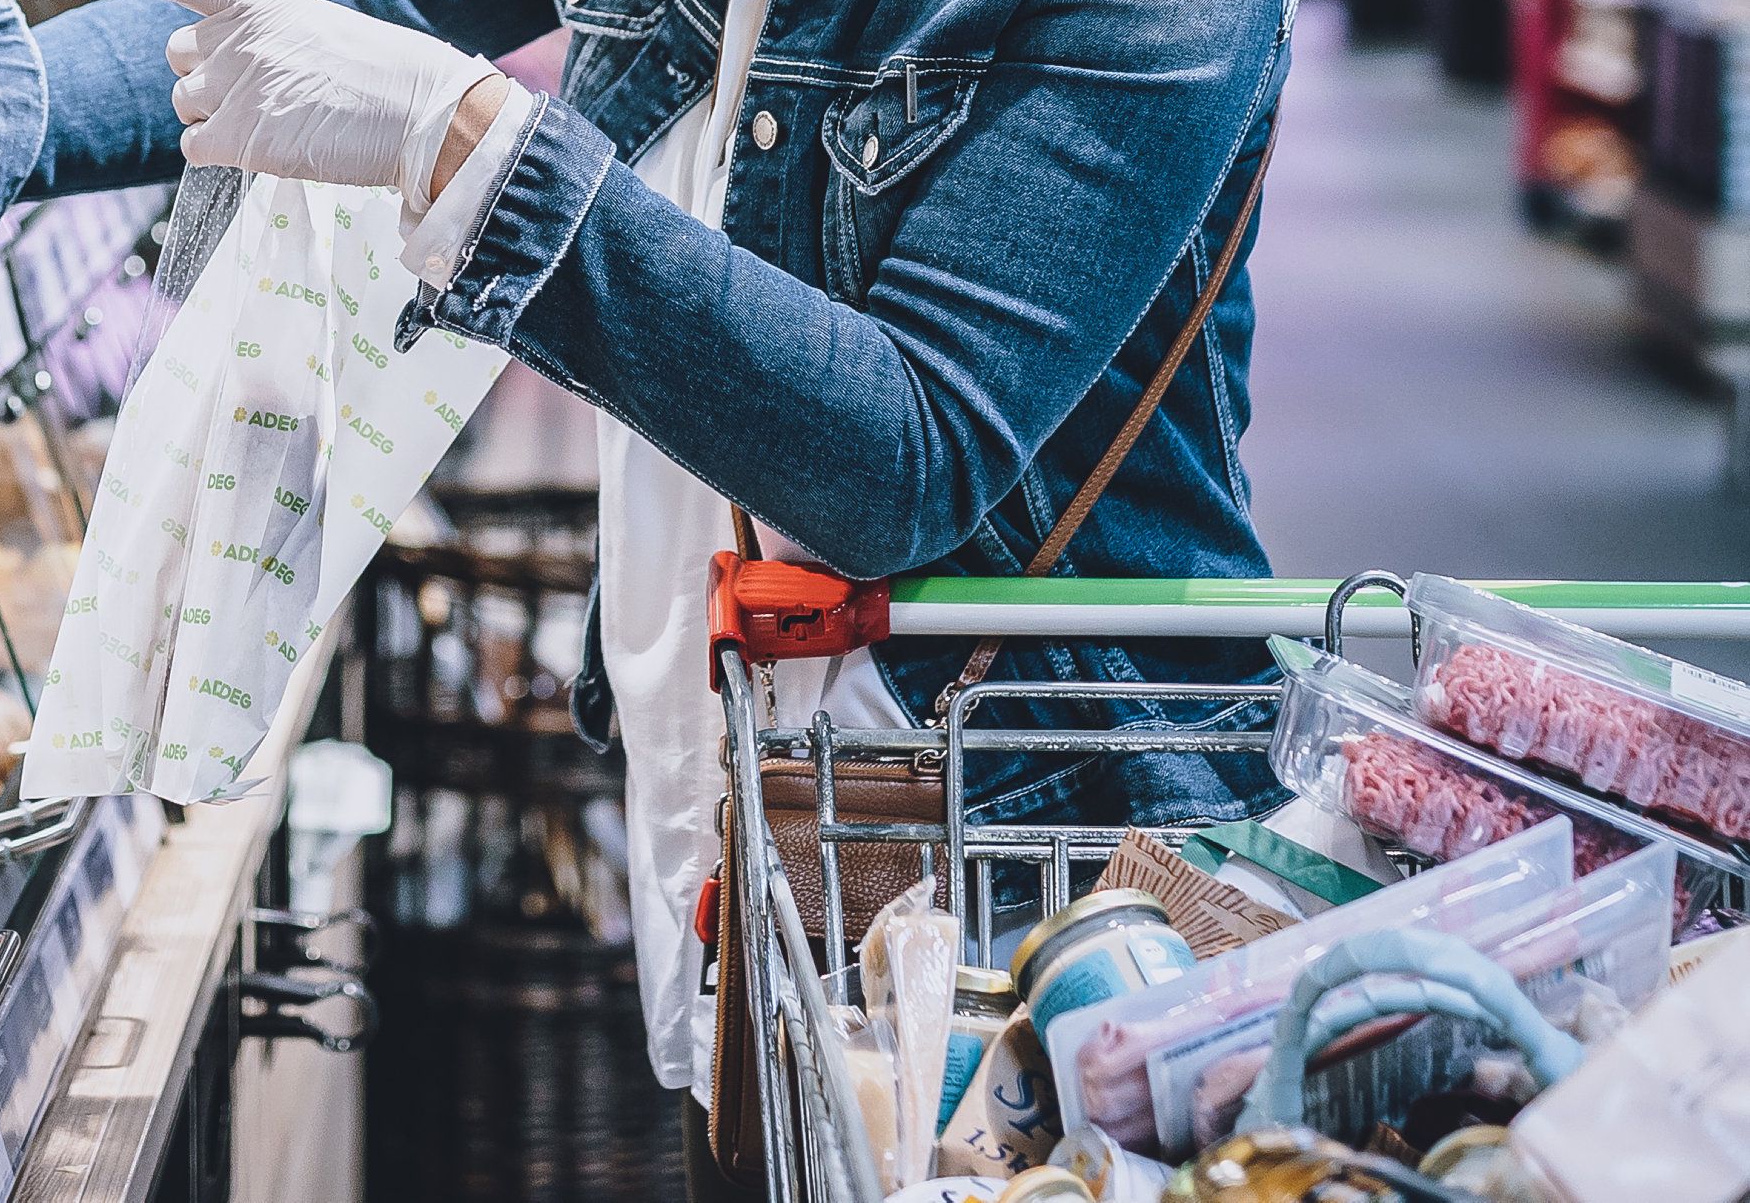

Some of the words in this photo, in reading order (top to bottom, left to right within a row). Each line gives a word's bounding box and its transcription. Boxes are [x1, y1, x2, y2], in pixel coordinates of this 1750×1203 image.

[334, 202, 352, 230] DEG
[275, 281, 327, 308] ADEG
[236, 341, 261, 358] EG
[352, 333, 389, 369] ADEG
[316, 363, 331, 382] AD
[248, 410, 299, 432] ADEG
[349, 417, 395, 454] ADEG
[207, 473, 236, 491] DEG
[362, 507, 392, 536] ADE
[223, 543, 260, 564] ADE
[266, 556, 296, 586] DEG
[182, 608, 211, 625] ADEG
[278, 641, 298, 663] AD
[70, 731, 103, 749] ADE
[162, 743, 188, 761] ADEG
